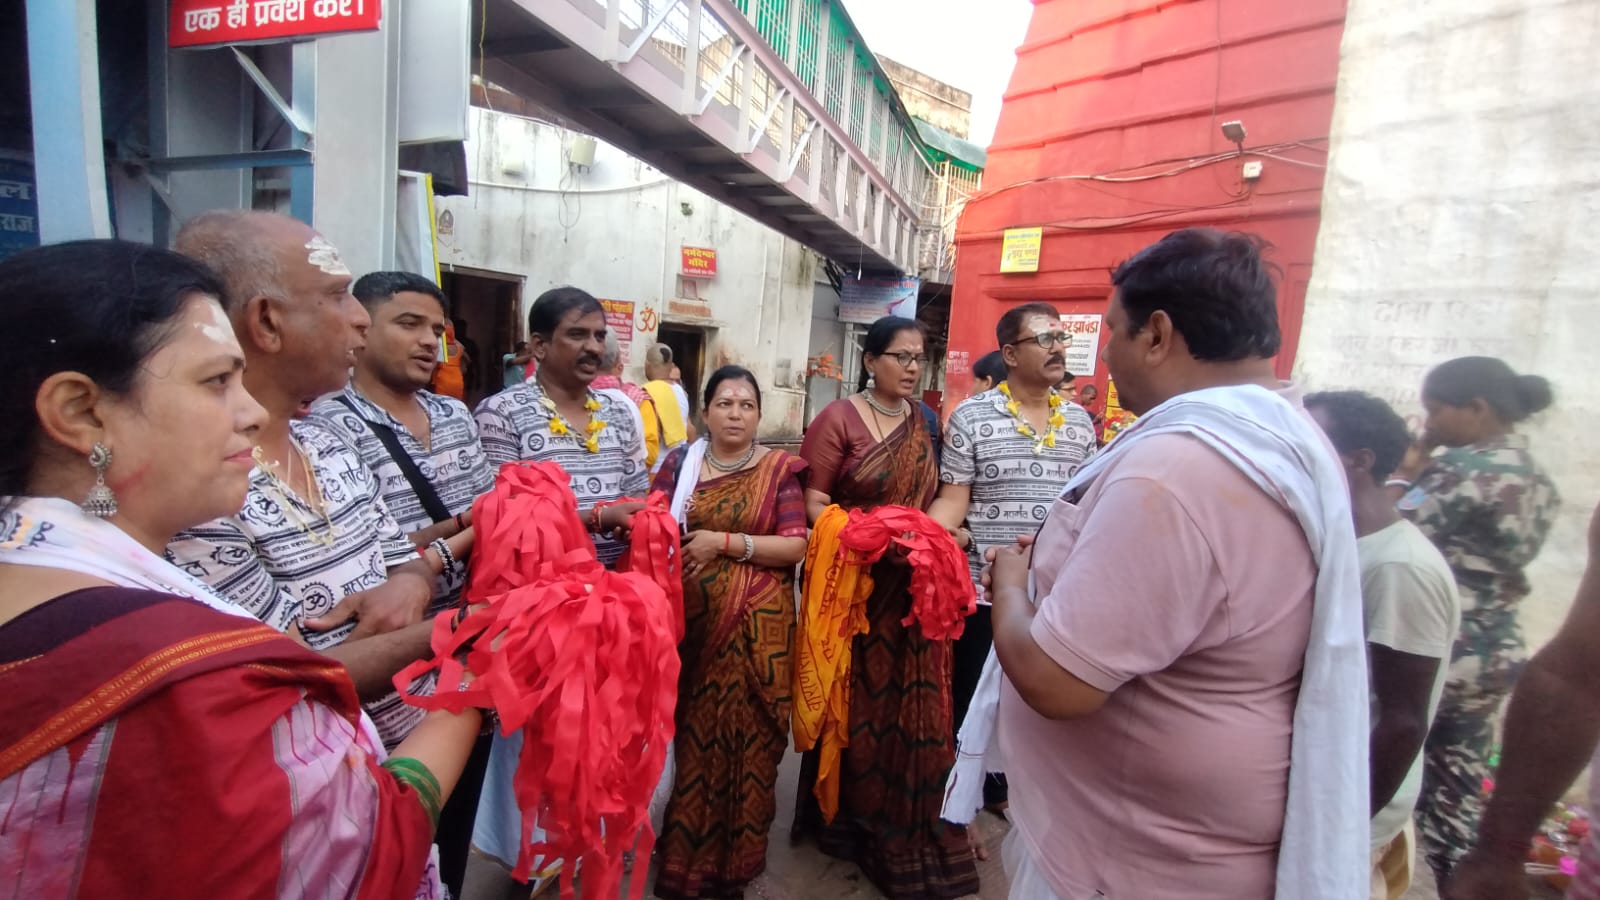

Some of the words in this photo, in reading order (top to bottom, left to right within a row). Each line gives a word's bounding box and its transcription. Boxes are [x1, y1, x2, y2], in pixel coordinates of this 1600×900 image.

[184, 6, 222, 33] एक
[226, 2, 249, 29] ही
[254, 0, 306, 27] प्रवश
